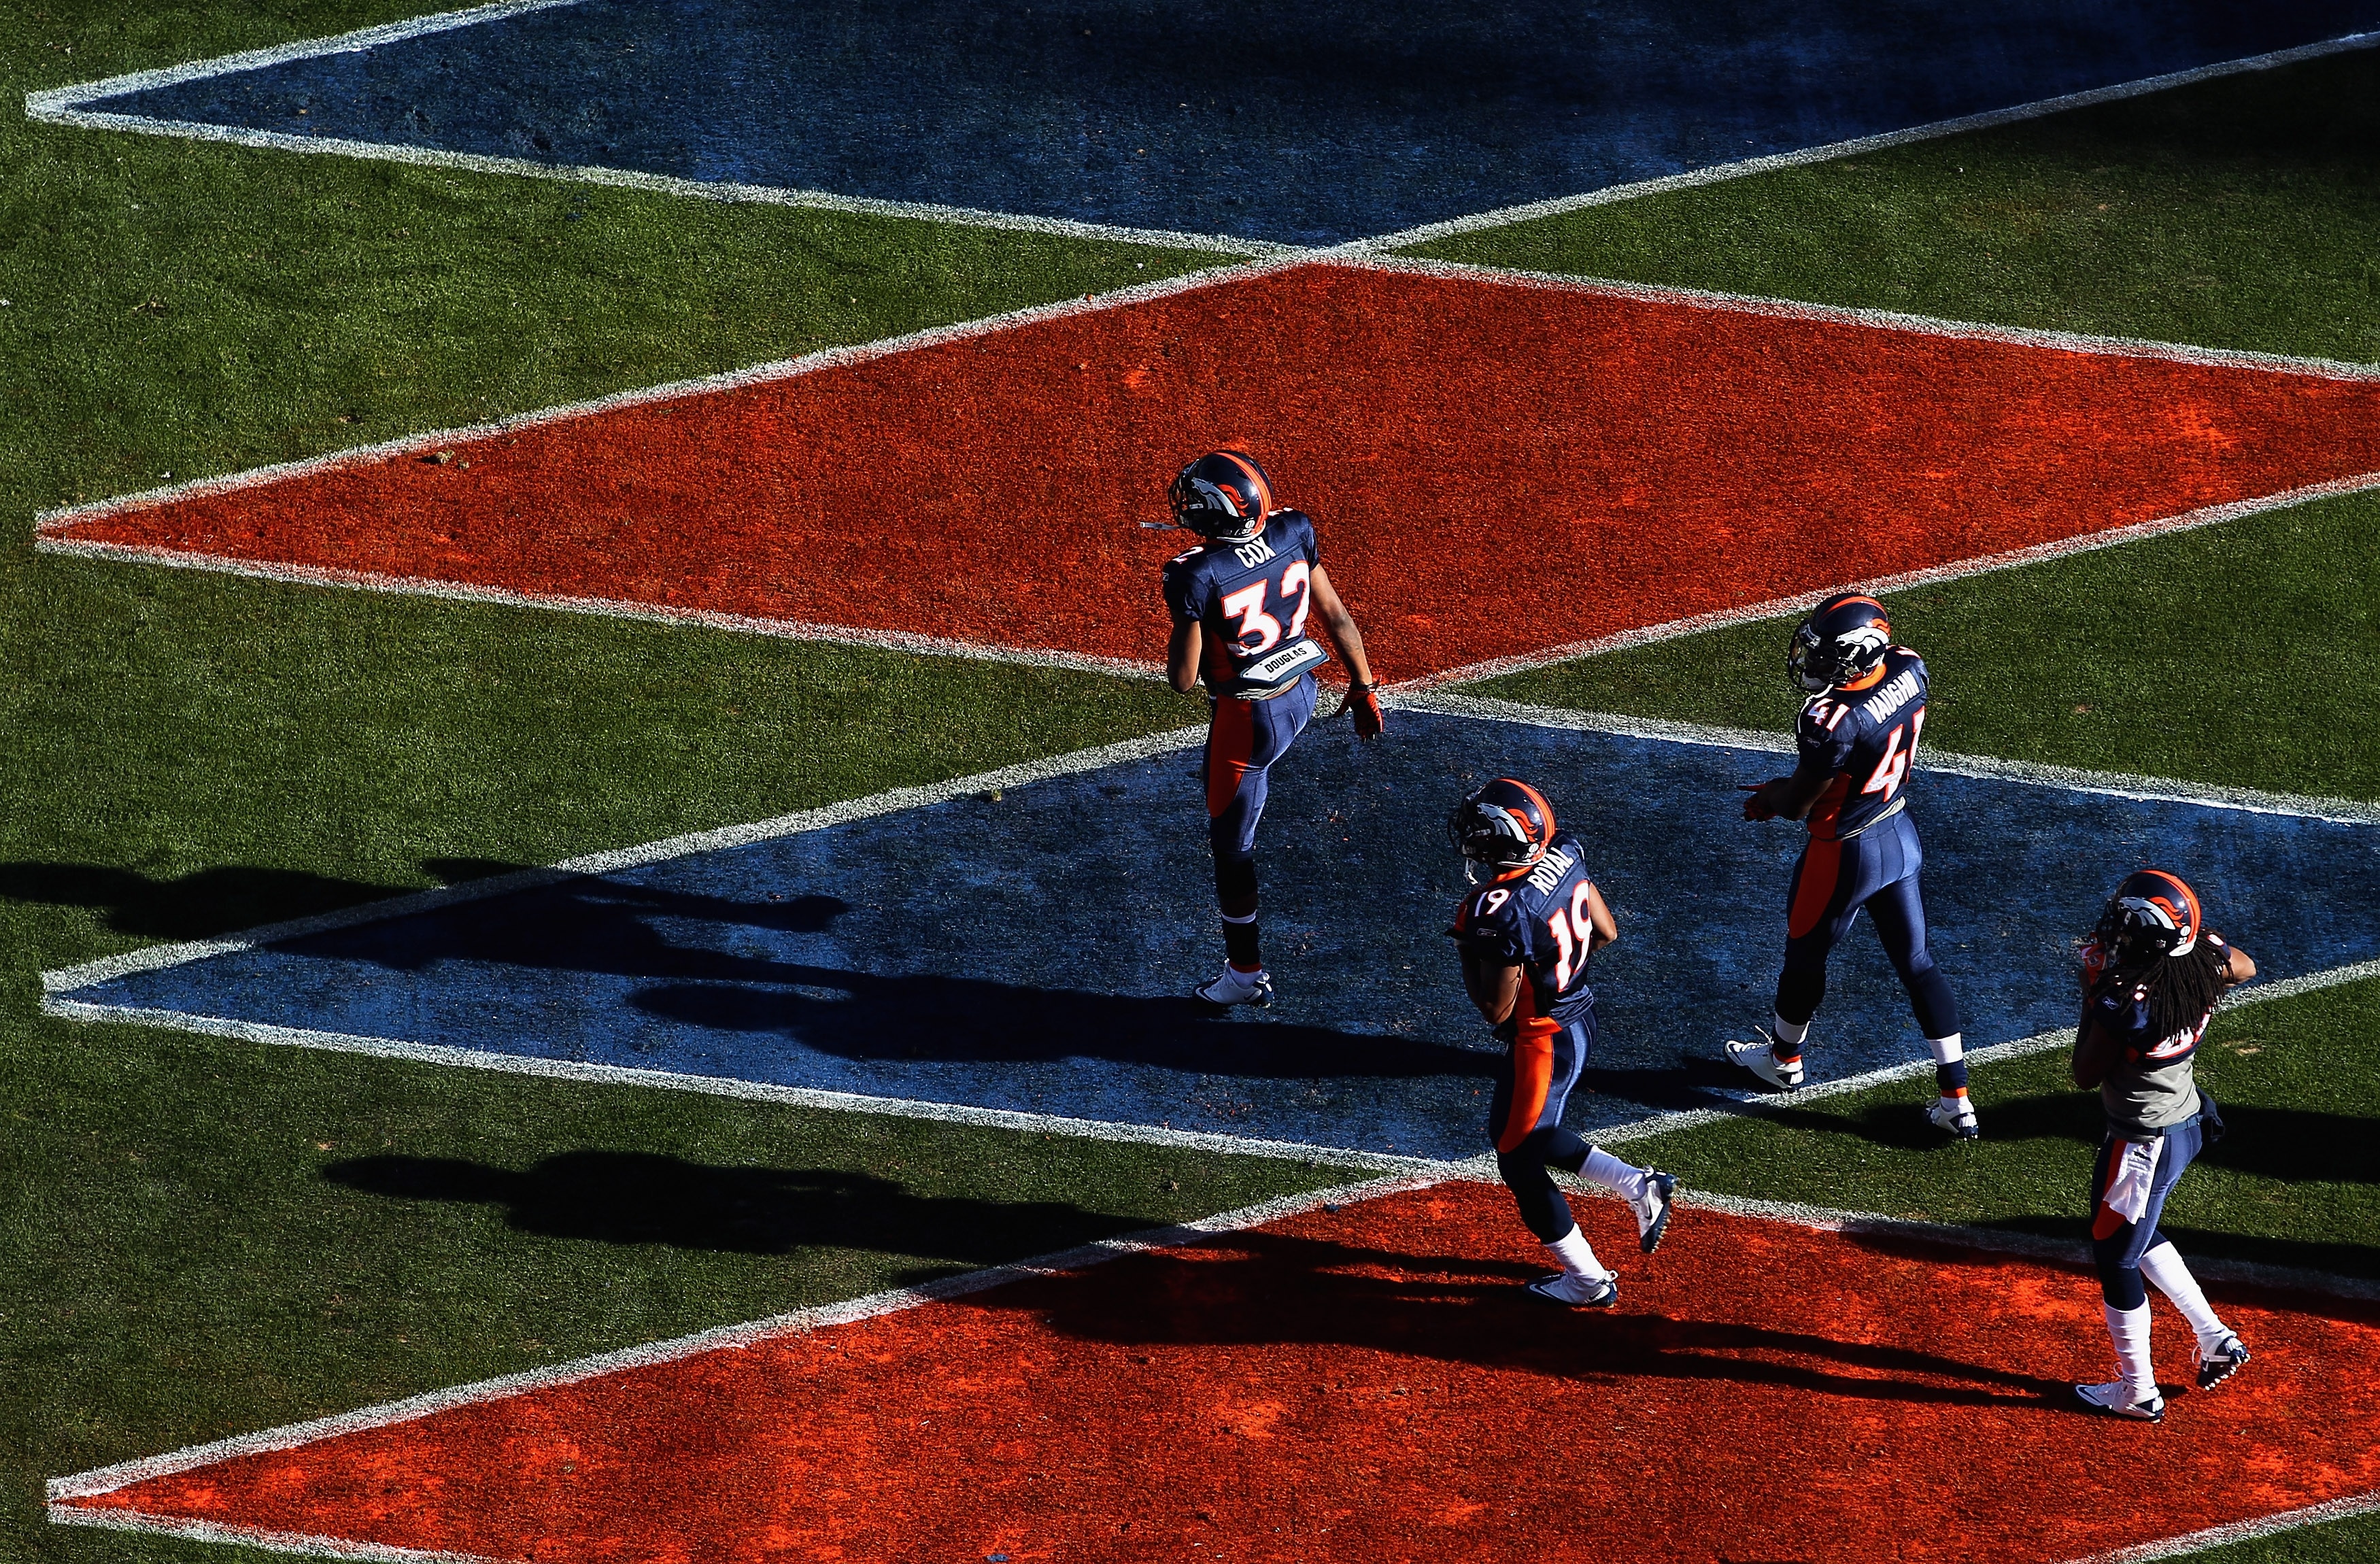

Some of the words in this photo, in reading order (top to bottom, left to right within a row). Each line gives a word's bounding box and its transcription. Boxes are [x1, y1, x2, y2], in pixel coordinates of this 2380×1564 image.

[1235, 537, 1276, 568] COX
[1221, 560, 1310, 658] 32
[1264, 647, 1307, 673] DOUGLAS
[1807, 698, 1850, 732] 41
[1863, 670, 1920, 724] VAUGHN
[1861, 706, 1926, 802] 41
[1527, 847, 1574, 896] ROYAL
[1474, 889, 1511, 917] 19
[1548, 879, 1593, 992] 19
